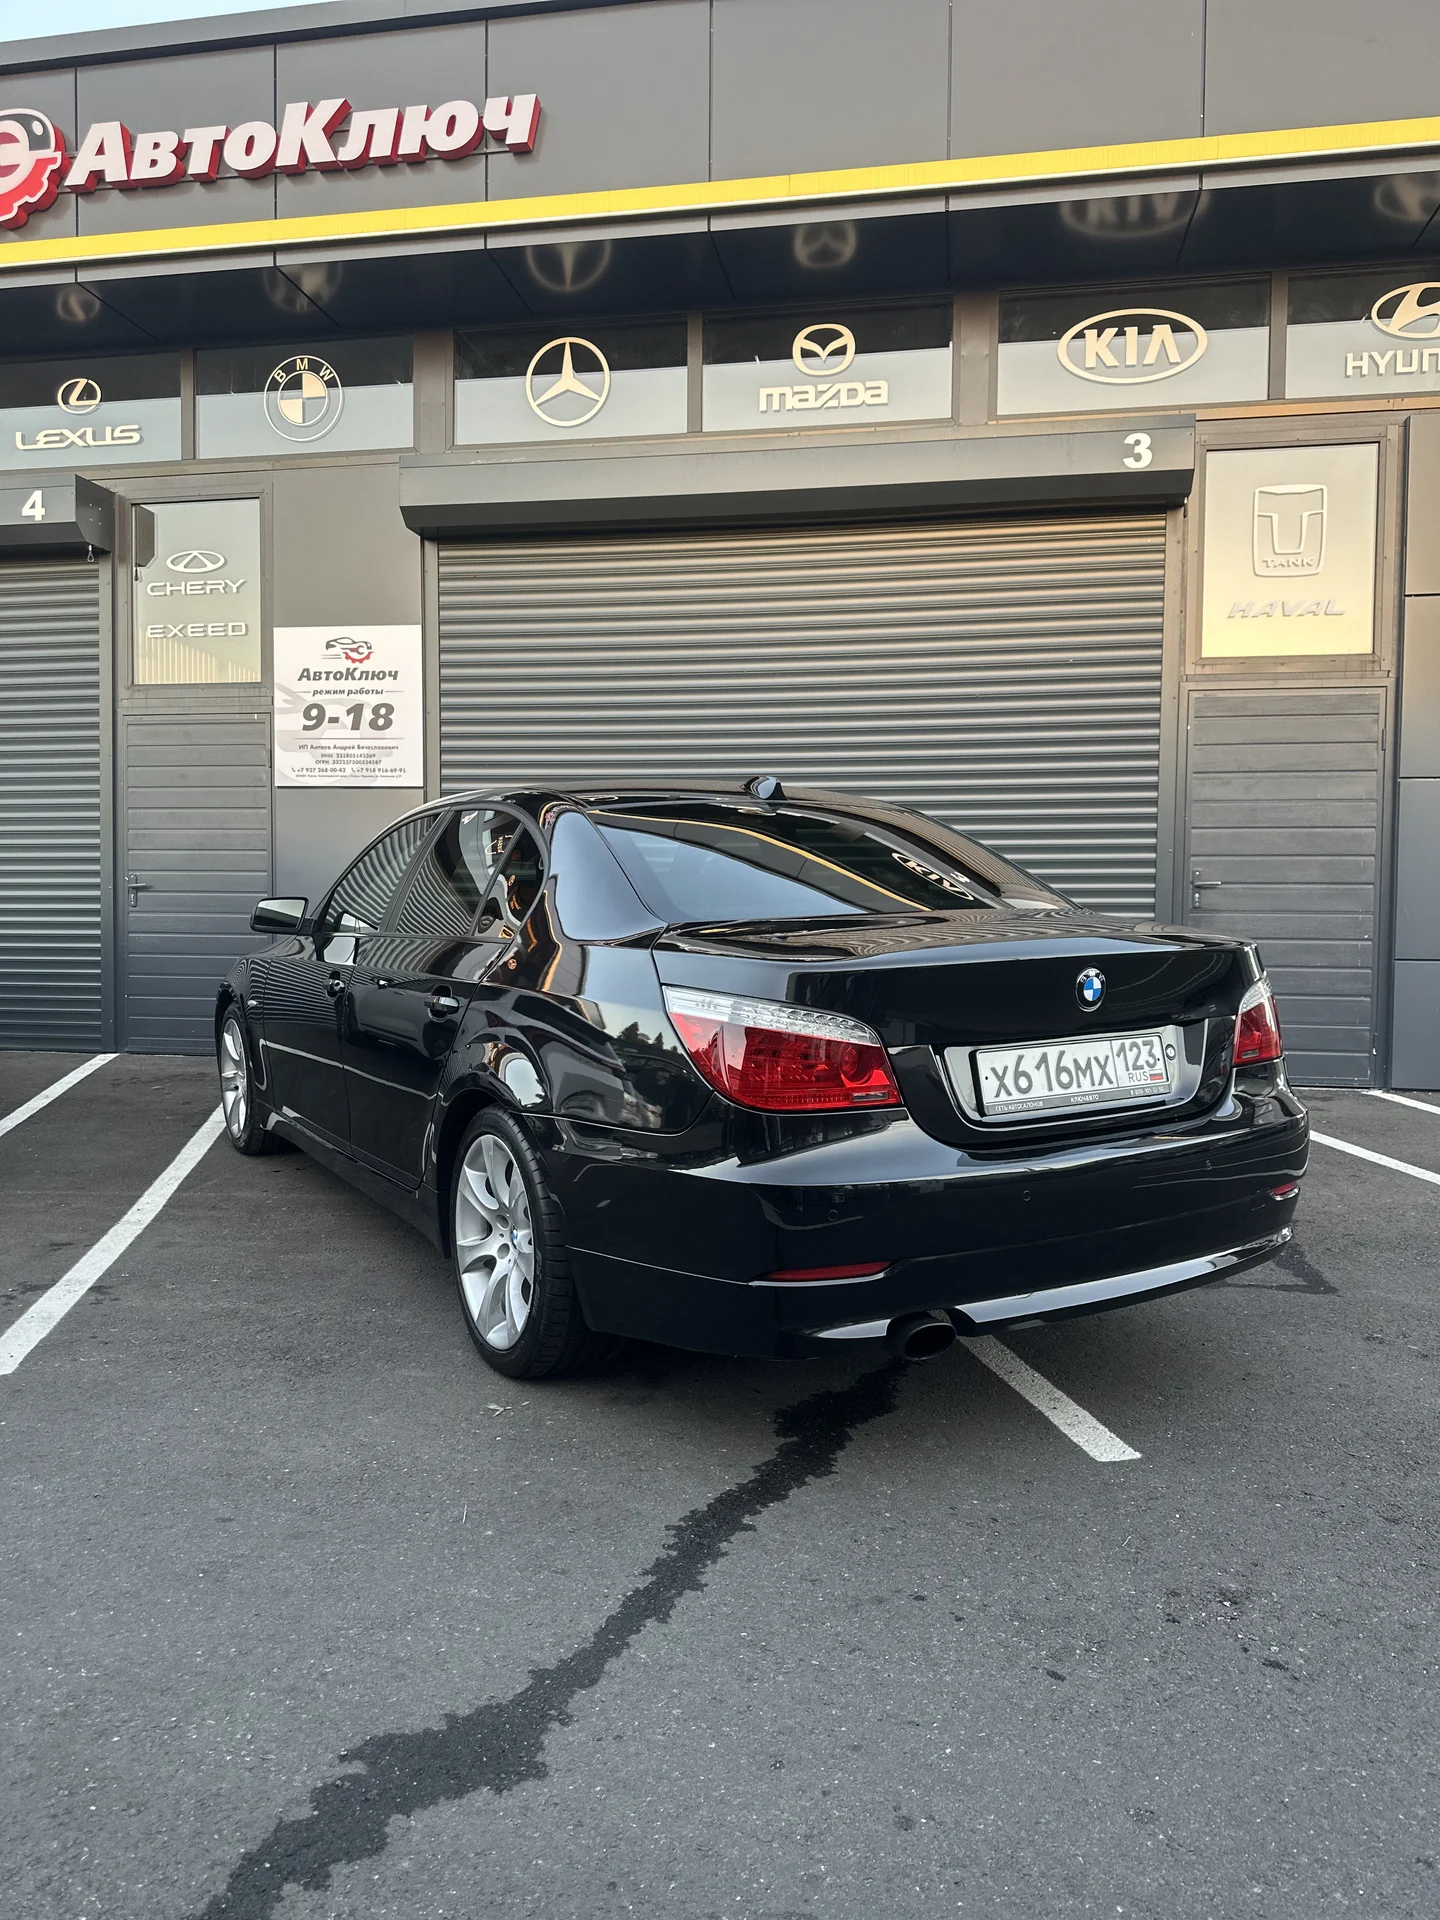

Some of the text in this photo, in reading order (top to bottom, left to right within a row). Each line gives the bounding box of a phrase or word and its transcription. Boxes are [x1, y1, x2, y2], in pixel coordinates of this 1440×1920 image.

[64, 93, 541, 193] АвтоКлюч
[1083, 324, 1181, 369] KIA
[273, 358, 335, 384] BMW
[15, 424, 142, 450] LEXUS
[1122, 432, 1153, 469] 3
[21, 490, 46, 521] 4
[1261, 557, 1315, 569] TANK
[146, 578, 246, 597] CHERY
[1227, 598, 1346, 619] HAVAL
[146, 621, 247, 638] EXEED
[297, 667, 399, 682] АвтоКлюч
[312, 687, 384, 697] режим работы
[302, 702, 395, 732] 9-18
[332, 744, 356, 752] Андрей
[1116, 1039, 1157, 1072] 123
[1128, 1070, 1149, 1083] RUS
[1008, 1100, 1044, 1110] АВТОСАЛОНОВ
